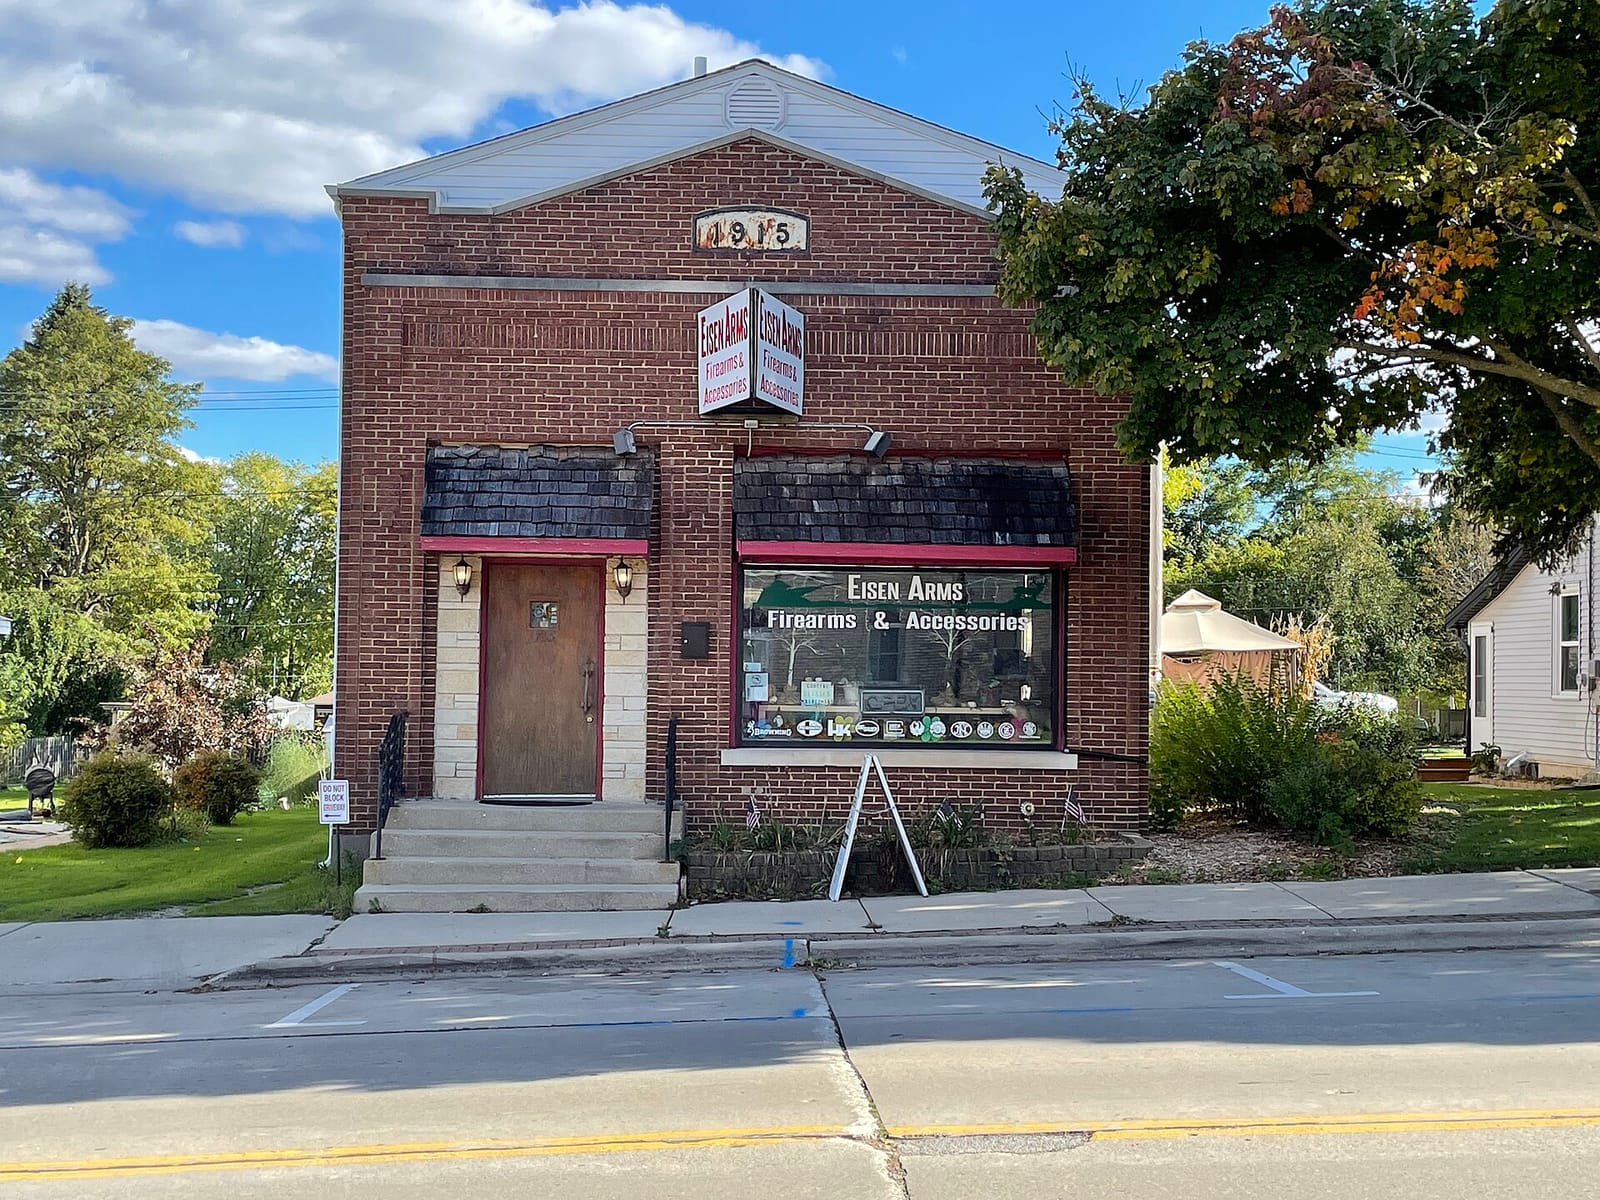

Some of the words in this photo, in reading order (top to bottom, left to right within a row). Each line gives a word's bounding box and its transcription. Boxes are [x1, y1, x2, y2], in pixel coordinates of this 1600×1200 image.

[714, 221, 790, 244] 1915
[700, 316, 724, 358] EISEN
[725, 304, 748, 349] ARMS
[782, 308, 802, 360] ARMS
[706, 354, 738, 380] Firearms
[738, 351, 745, 368] &
[763, 349, 792, 378] Firearms
[792, 366, 798, 382] &
[703, 377, 747, 406] Accessories
[760, 373, 799, 407] Accessories
[847, 574, 900, 600] EISEN
[907, 575, 963, 601] ARMS
[767, 610, 857, 629] Firearms
[873, 611, 890, 630] &
[906, 611, 1029, 631] Accessories
